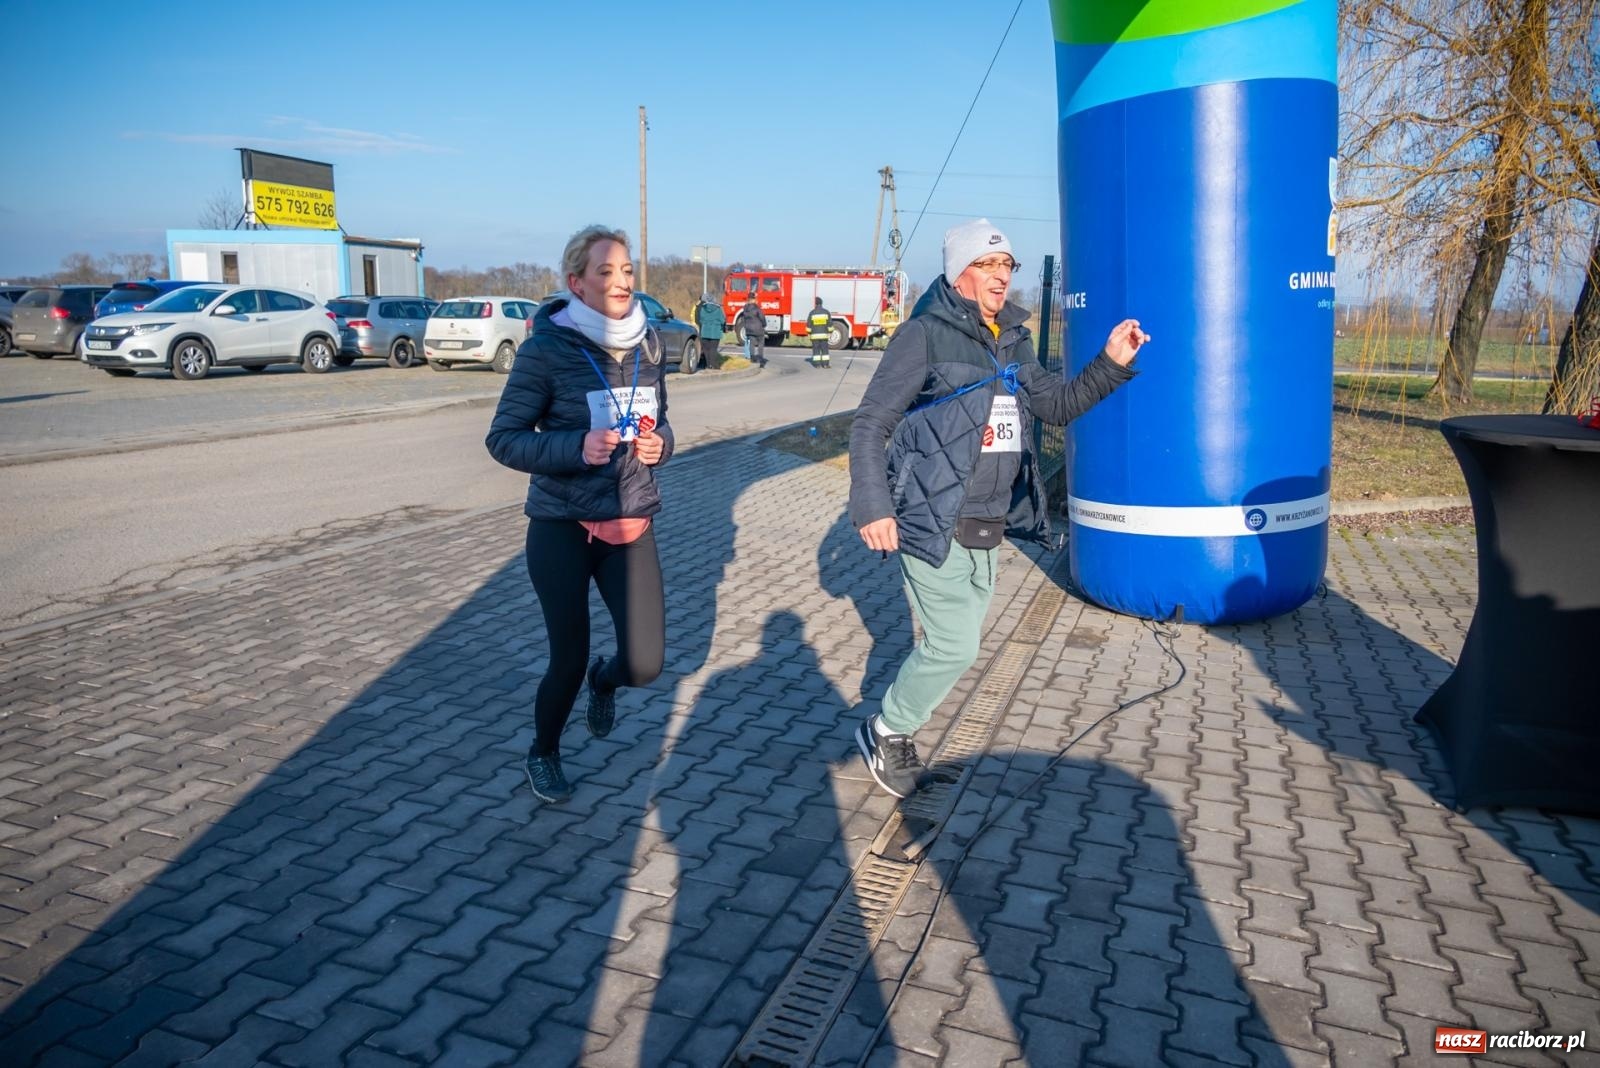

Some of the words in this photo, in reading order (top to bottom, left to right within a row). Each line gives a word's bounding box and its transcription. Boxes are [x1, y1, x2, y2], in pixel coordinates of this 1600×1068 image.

[297, 191, 323, 199] SZAMBA
[256, 195, 282, 212] 575
[286, 199, 310, 215] 792
[313, 202, 335, 218] 626
[997, 422, 1014, 440] 85
